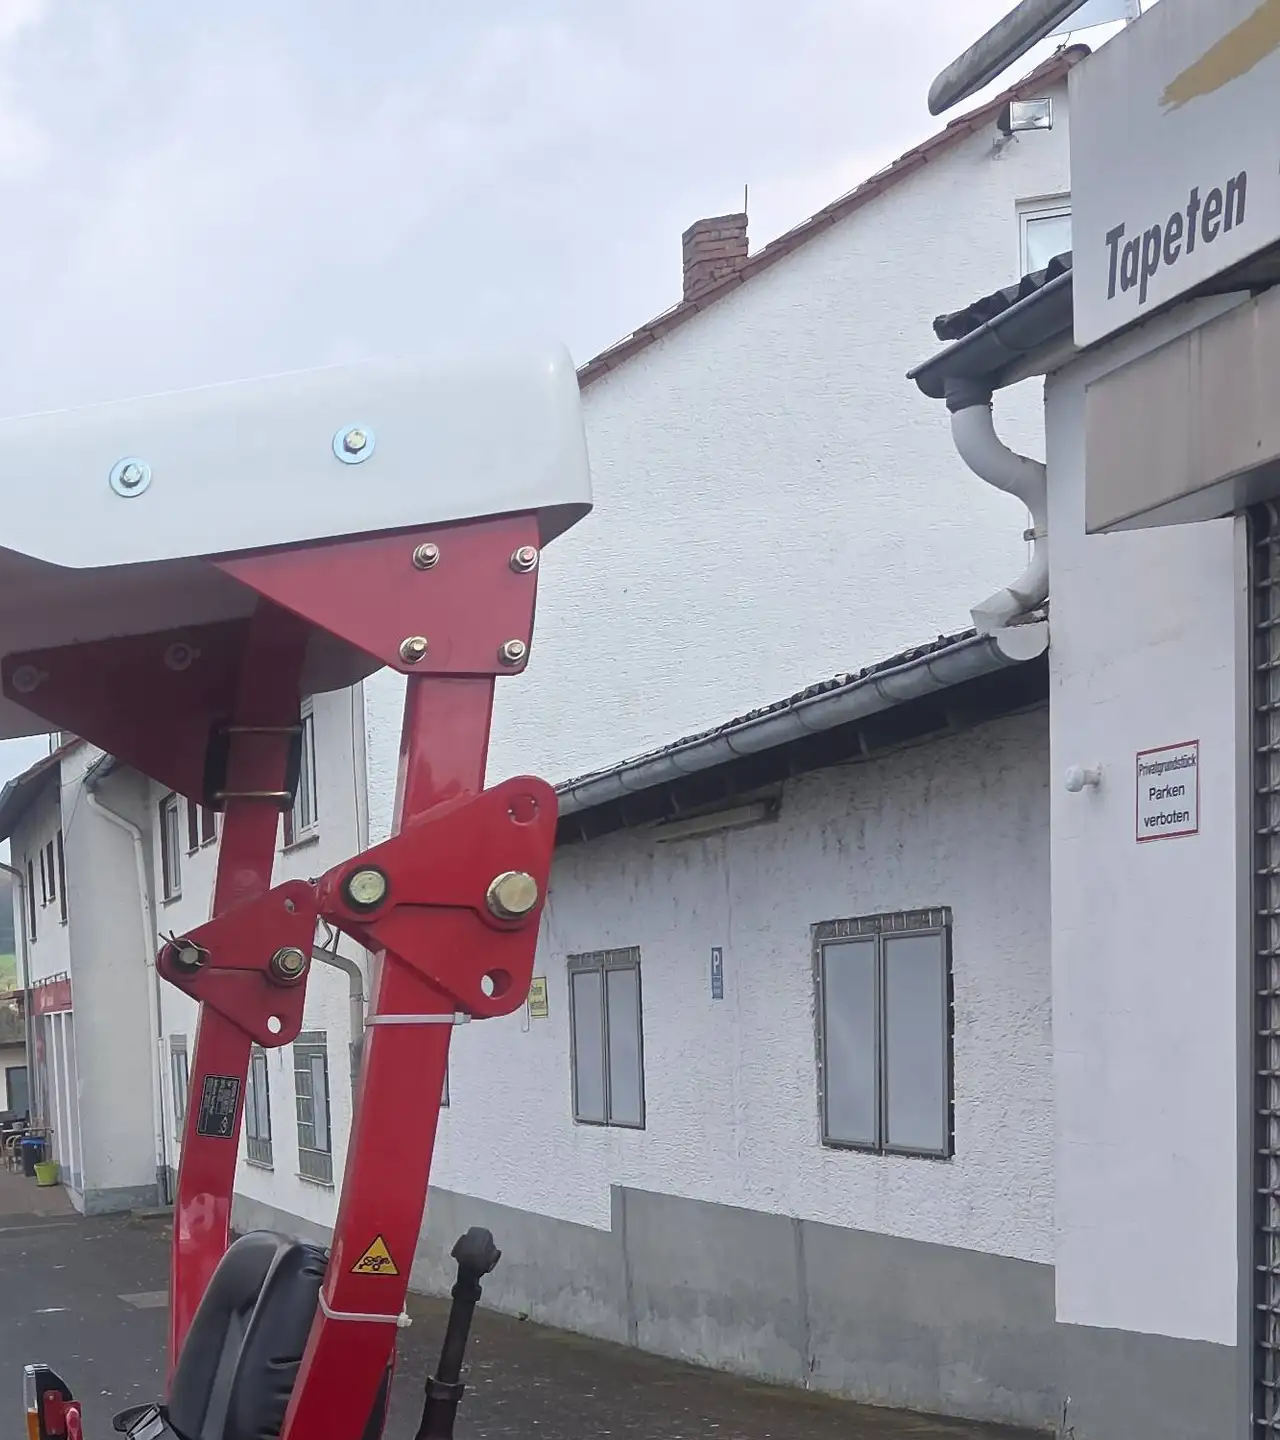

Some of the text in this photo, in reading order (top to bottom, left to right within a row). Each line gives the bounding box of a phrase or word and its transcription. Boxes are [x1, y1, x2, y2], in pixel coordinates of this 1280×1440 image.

[1105, 171, 1247, 305] Tapeten
[1139, 753, 1197, 776] Privatgrundstück
[1149, 784, 1185, 801] Parken
[1144, 810, 1190, 828] verboten
[713, 951, 720, 973] P
